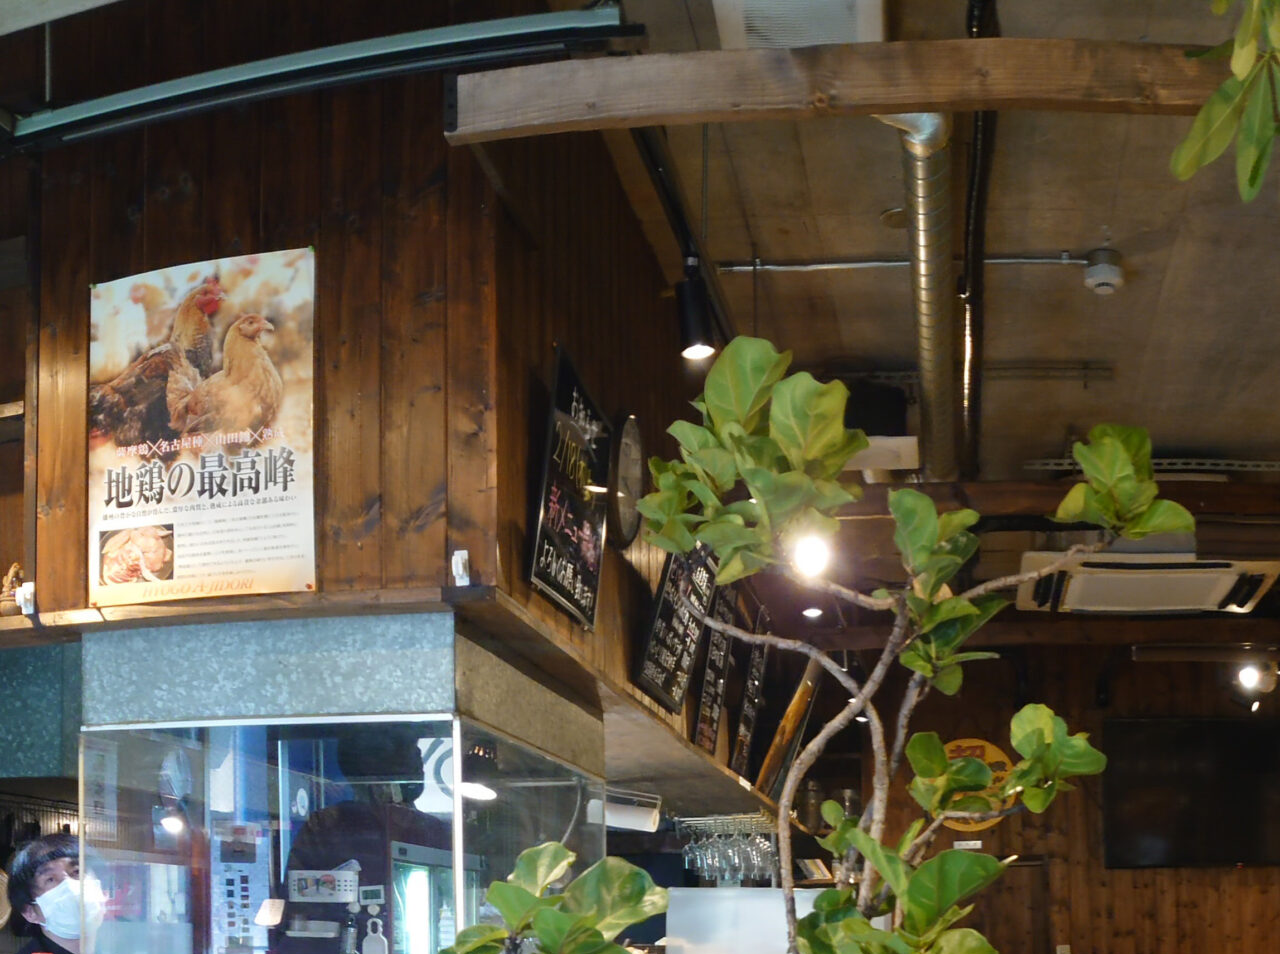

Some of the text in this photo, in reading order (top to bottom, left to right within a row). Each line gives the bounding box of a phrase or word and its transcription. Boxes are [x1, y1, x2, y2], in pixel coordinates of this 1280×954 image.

[103, 446, 296, 508] 地鶏の最高峰
